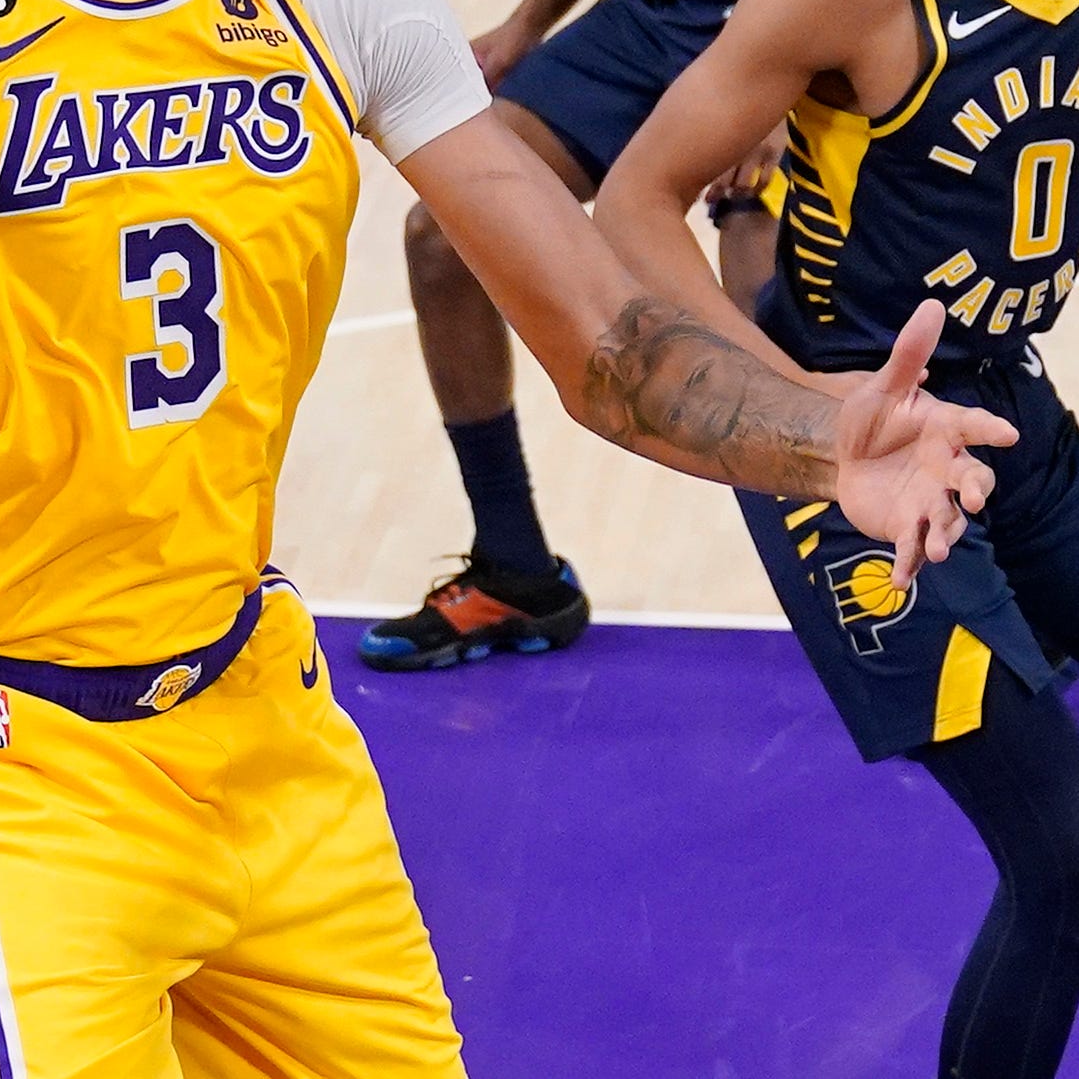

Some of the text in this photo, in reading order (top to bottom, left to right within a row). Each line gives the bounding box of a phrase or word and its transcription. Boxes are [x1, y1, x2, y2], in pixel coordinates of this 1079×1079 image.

[216, 22, 288, 48] bibigo
[1010, 137, 1075, 262] 0
[118, 217, 228, 430] 3
